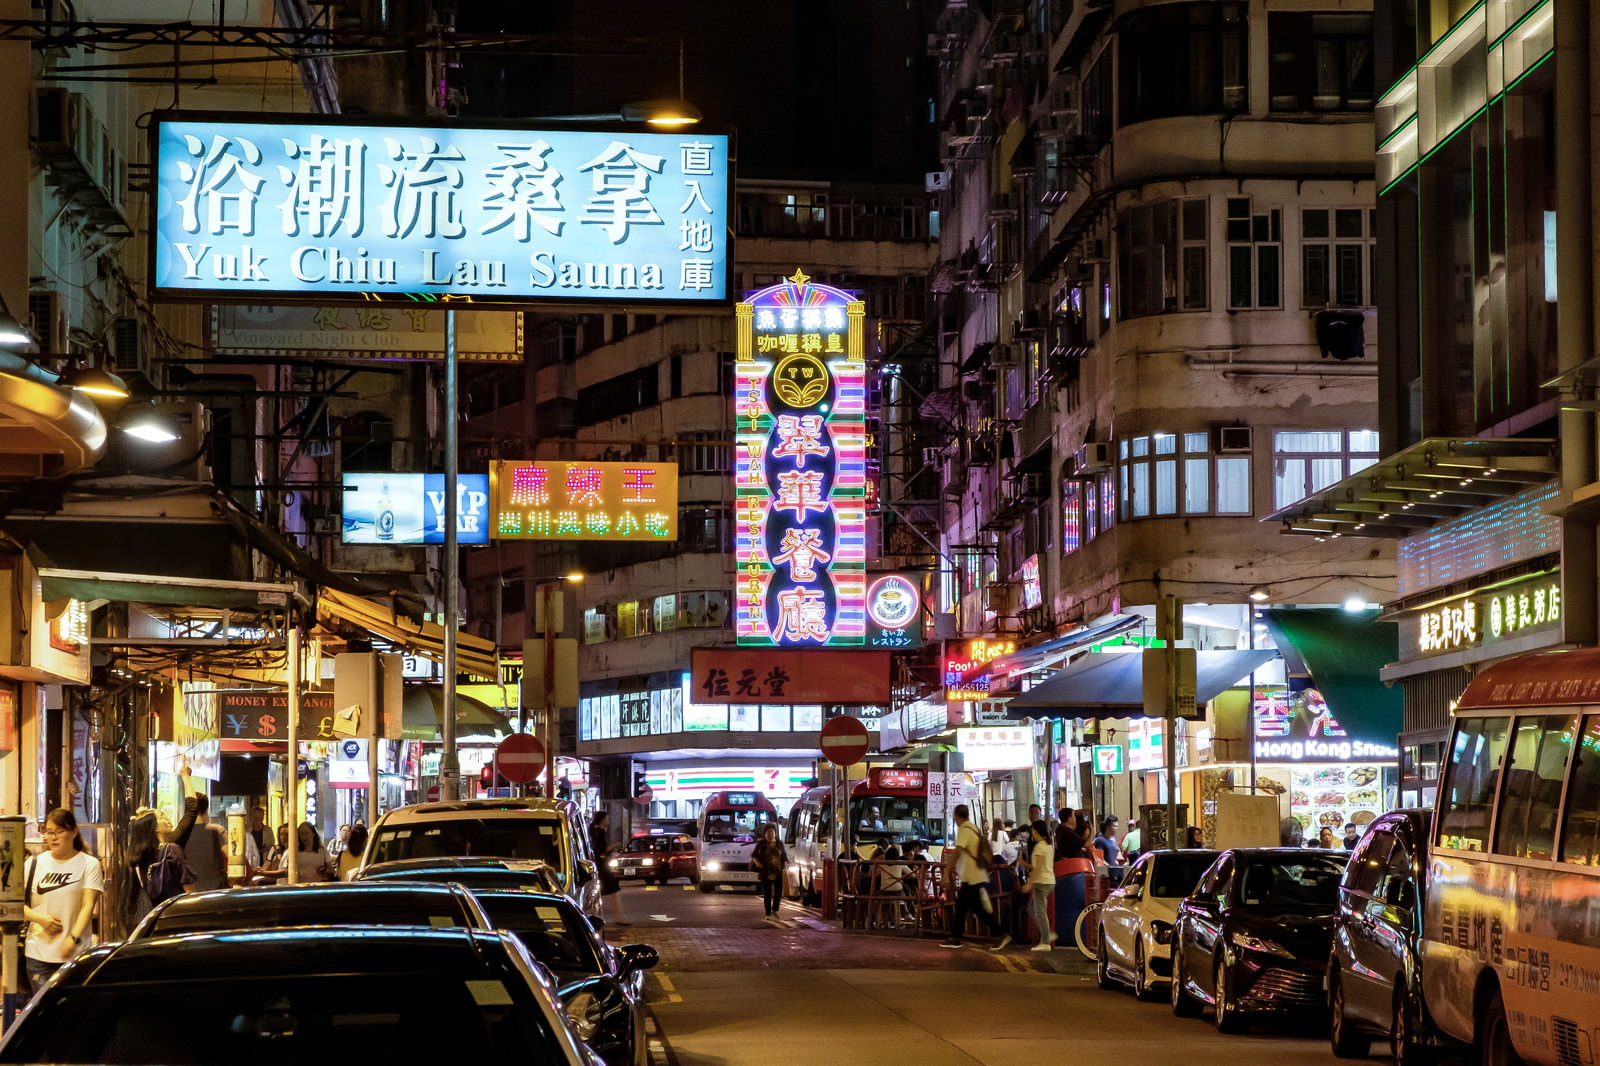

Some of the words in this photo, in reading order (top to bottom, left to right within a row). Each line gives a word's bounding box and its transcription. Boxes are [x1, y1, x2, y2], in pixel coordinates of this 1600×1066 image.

[175, 134, 664, 243] 浴潮流桑拿
[679, 141, 714, 292] 直入地庫
[174, 243, 268, 282] Yuk
[290, 247, 397, 285] Chiu
[421, 249, 507, 287] Lau
[530, 252, 664, 290] Sauna
[231, 331, 304, 351] Vineyard
[311, 332, 356, 347] Night
[362, 332, 400, 346] Club
[748, 378, 760, 432] TSUI
[747, 445, 762, 484] WAH
[510, 464, 657, 506] 麻辣王
[772, 414, 831, 642] 翠華餐廳
[747, 496, 761, 633] RESTAURANT
[872, 637, 912, 646] レストラン
[702, 667, 790, 697] 位元堂
[948, 661, 971, 671] Foot
[226, 697, 268, 707] MONEY
[1256, 742, 1302, 759] Hong
[1305, 741, 1351, 759] Kong
[41, 872, 73, 884] NIKE
